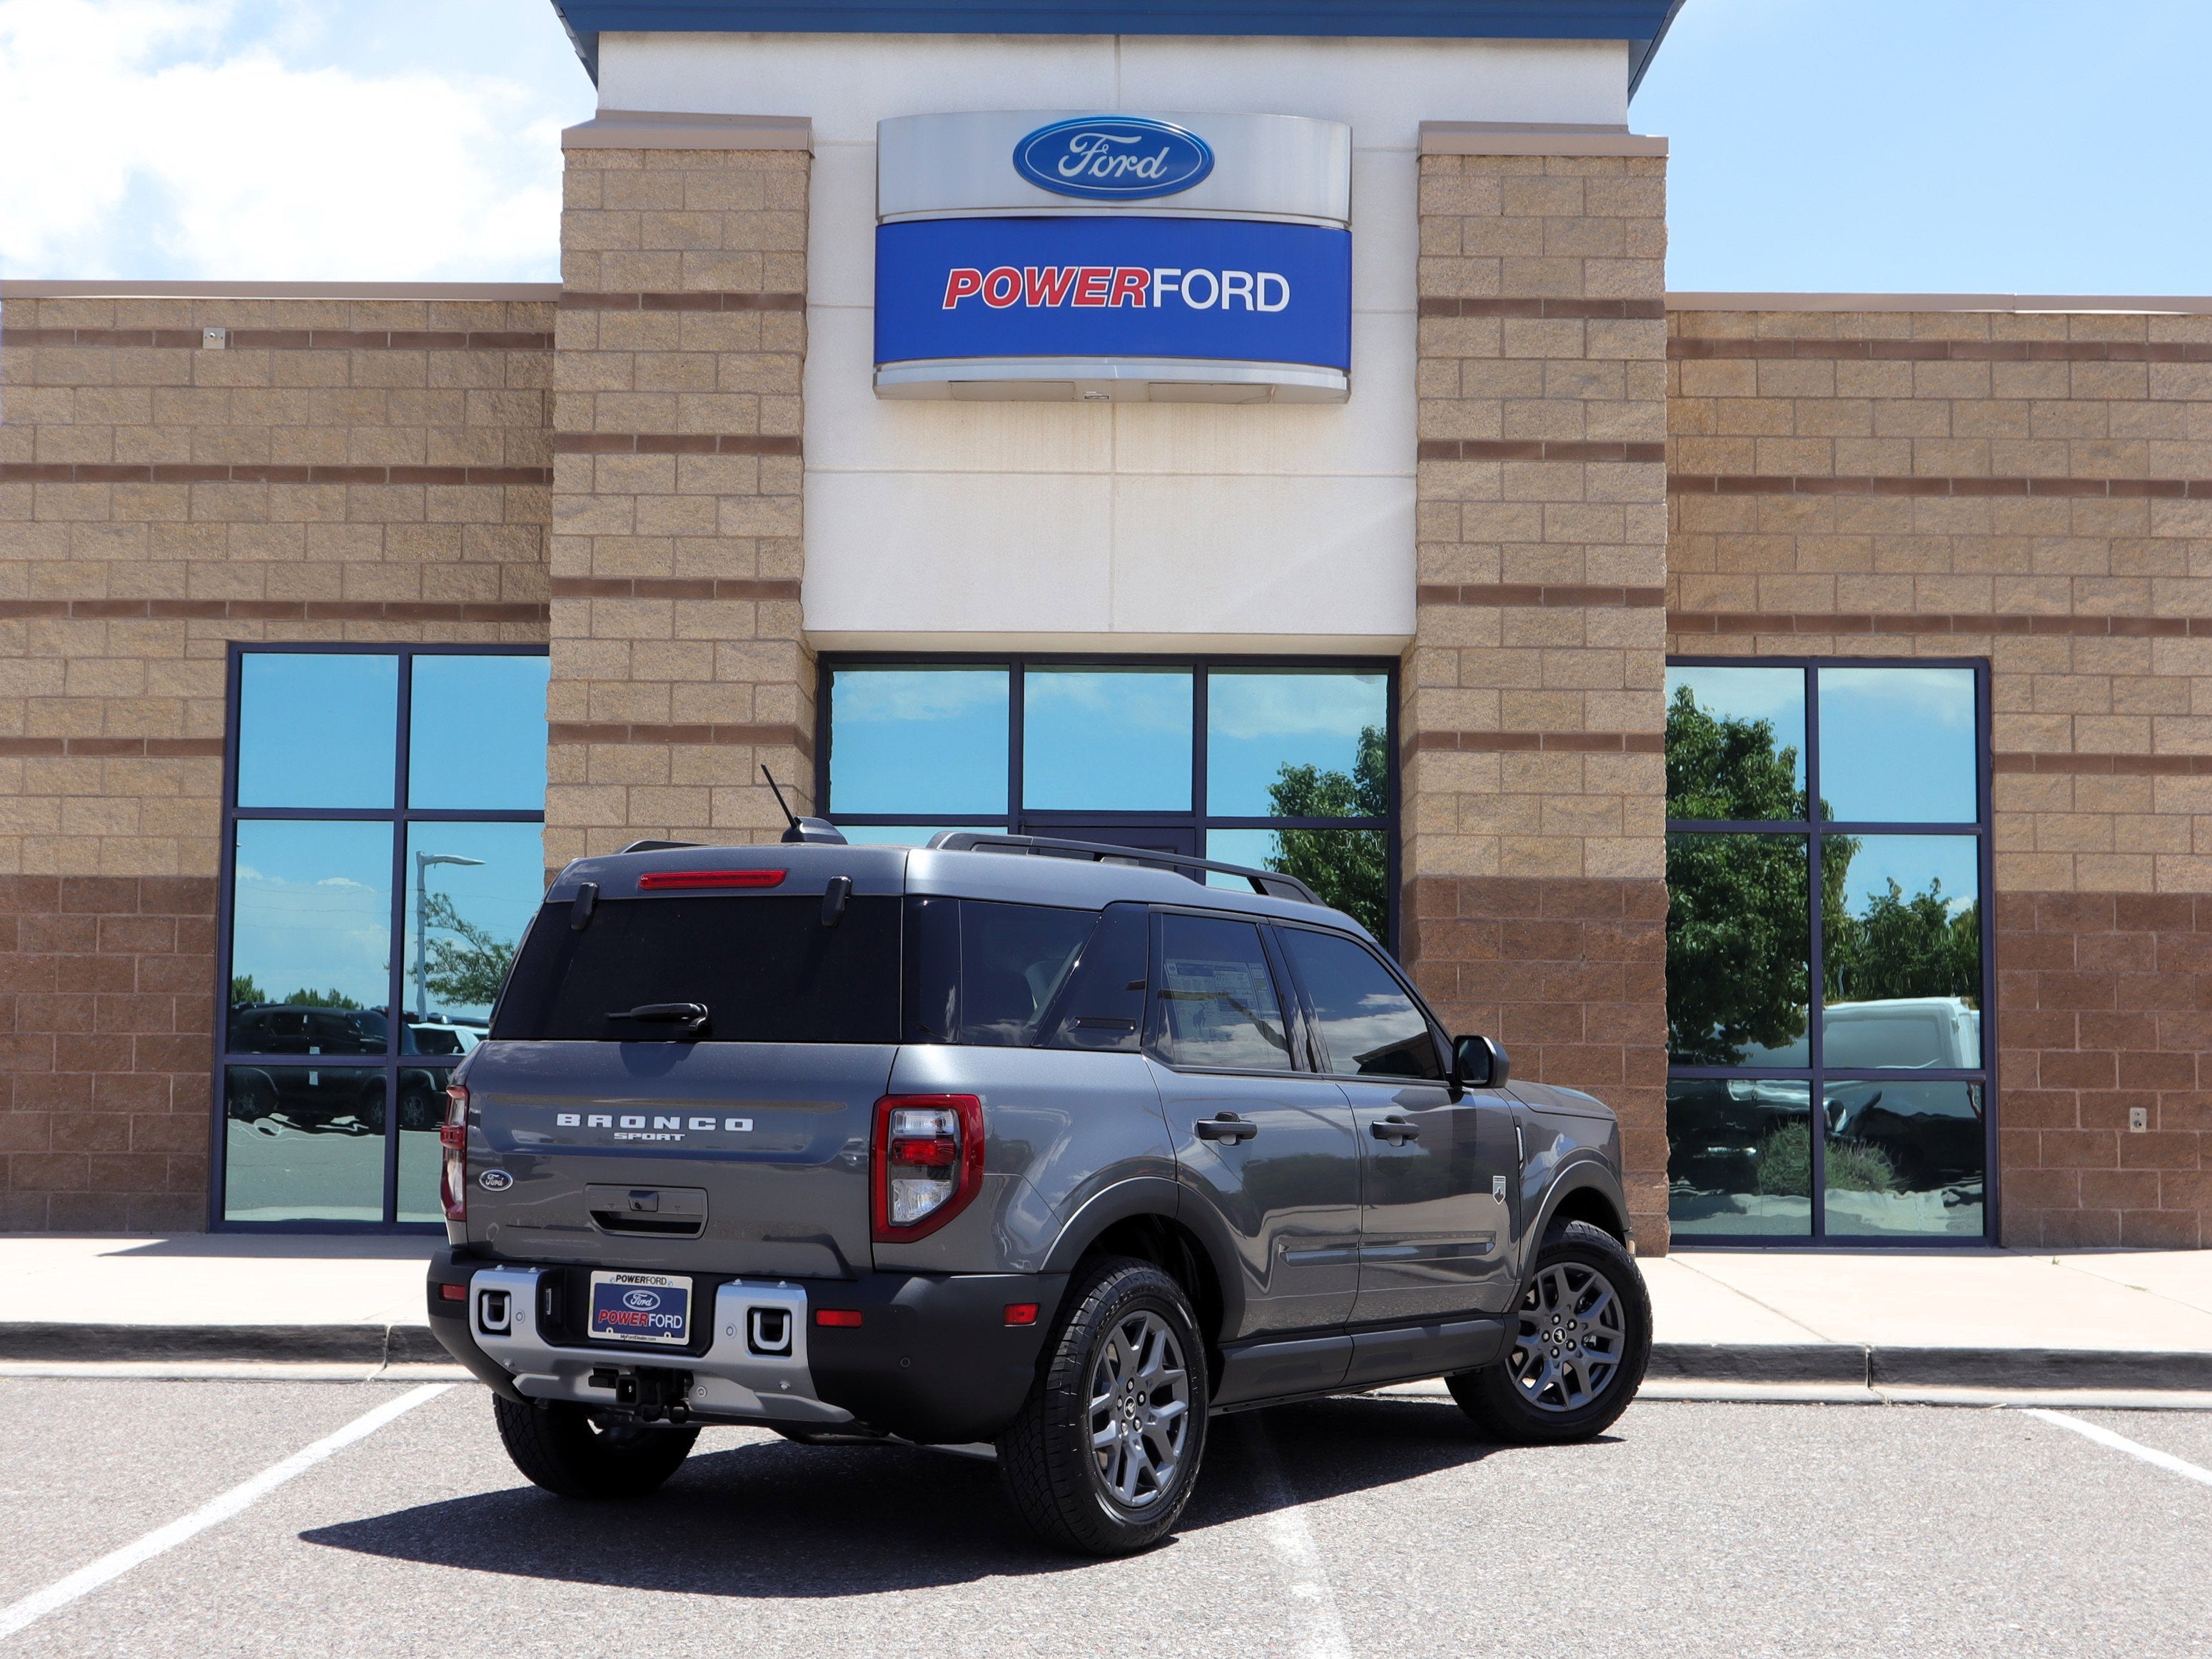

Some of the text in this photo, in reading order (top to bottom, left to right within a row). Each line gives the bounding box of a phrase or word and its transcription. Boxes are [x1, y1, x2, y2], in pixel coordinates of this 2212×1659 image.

[1058, 131, 1170, 179] Ford
[943, 266, 1291, 312] POWERFORD
[557, 1113, 754, 1131] BRONCO
[614, 1132, 685, 1141] SPORT
[485, 1174, 504, 1186] Ford
[616, 1275, 667, 1285] POWERFORD
[630, 1294, 652, 1306] Ford
[598, 1310, 682, 1328] POWERFORD
